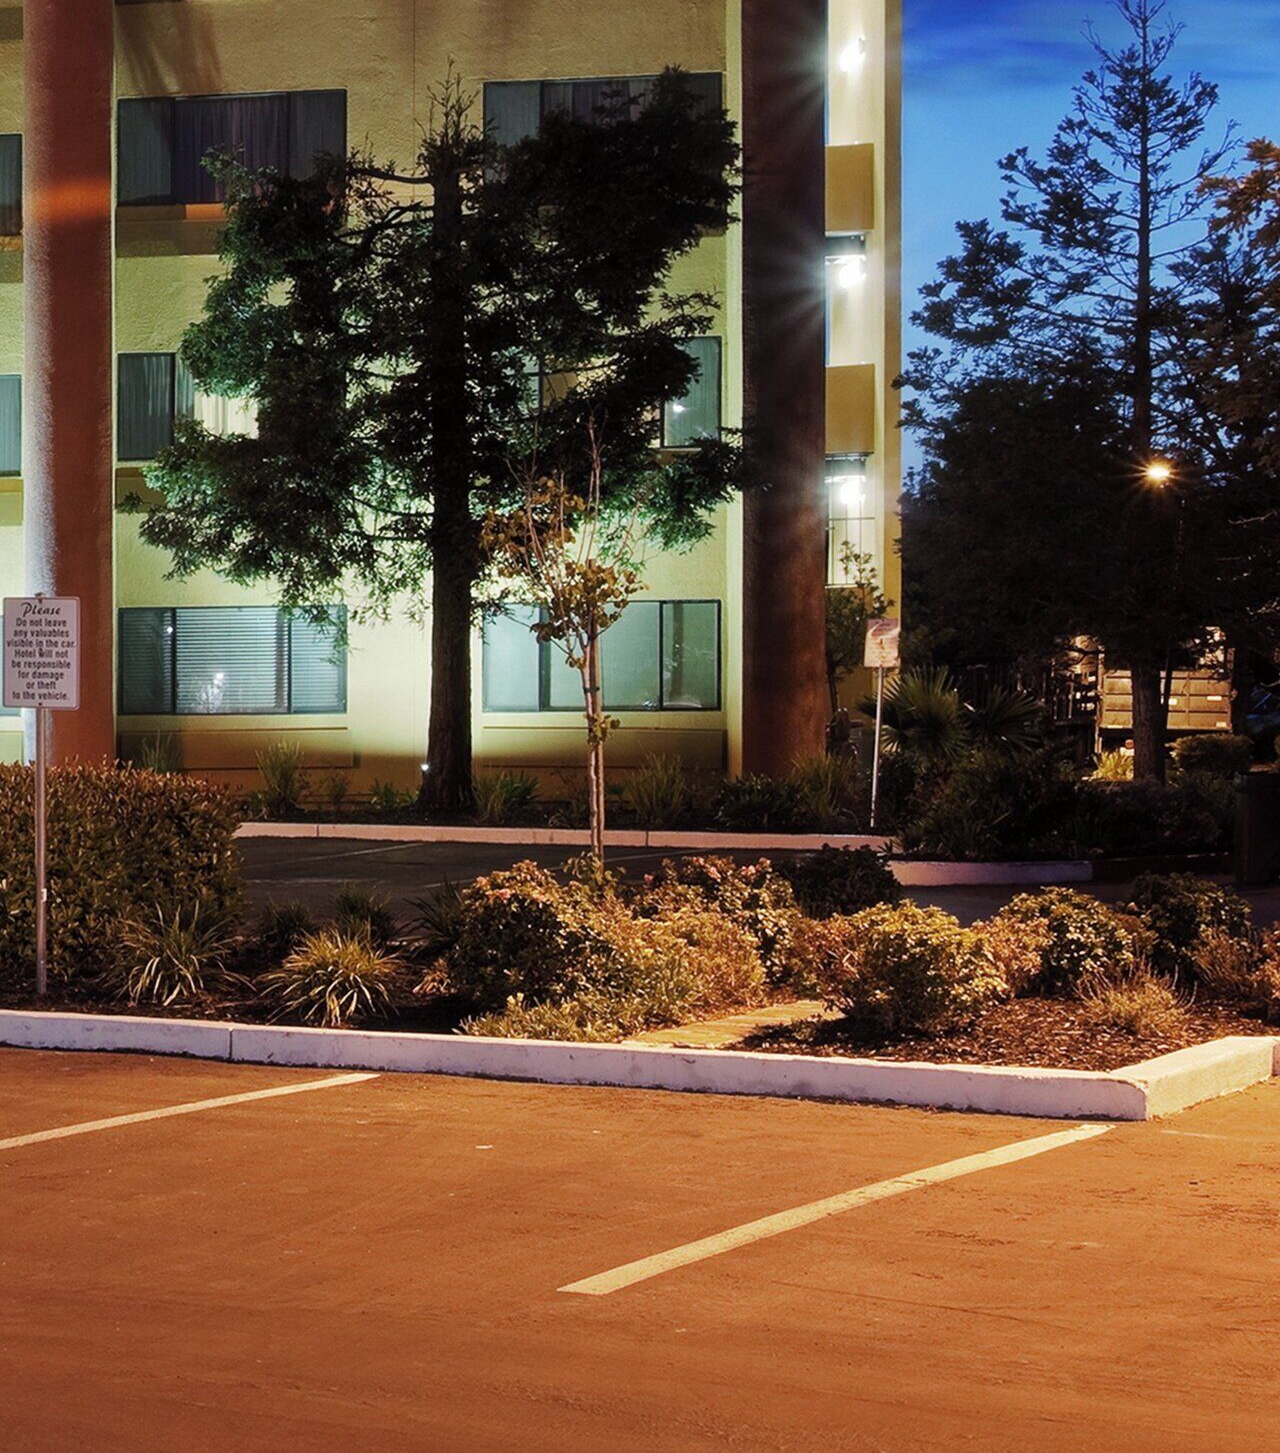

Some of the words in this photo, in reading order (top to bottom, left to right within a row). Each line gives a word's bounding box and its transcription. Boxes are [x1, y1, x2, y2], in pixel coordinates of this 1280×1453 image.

[21, 602, 61, 617] Please
[16, 617, 27, 627] Do
[29, 618, 42, 627] not
[44, 618, 67, 627] leave
[13, 629, 28, 638] any
[30, 628, 69, 638] valuables
[6, 638, 33, 648] visible
[35, 639, 44, 648] in
[45, 639, 59, 648] the
[14, 649, 36, 658] Hotel
[38, 649, 53, 658] will
[55, 649, 68, 658] not
[11, 659, 21, 668] be
[23, 660, 71, 670] responsible
[18, 670, 29, 679] for
[31, 670, 64, 681] damage
[26, 681, 35, 689] or
[37, 681, 56, 689] theft
[12, 691, 20, 700] to
[22, 691, 35, 700] the
